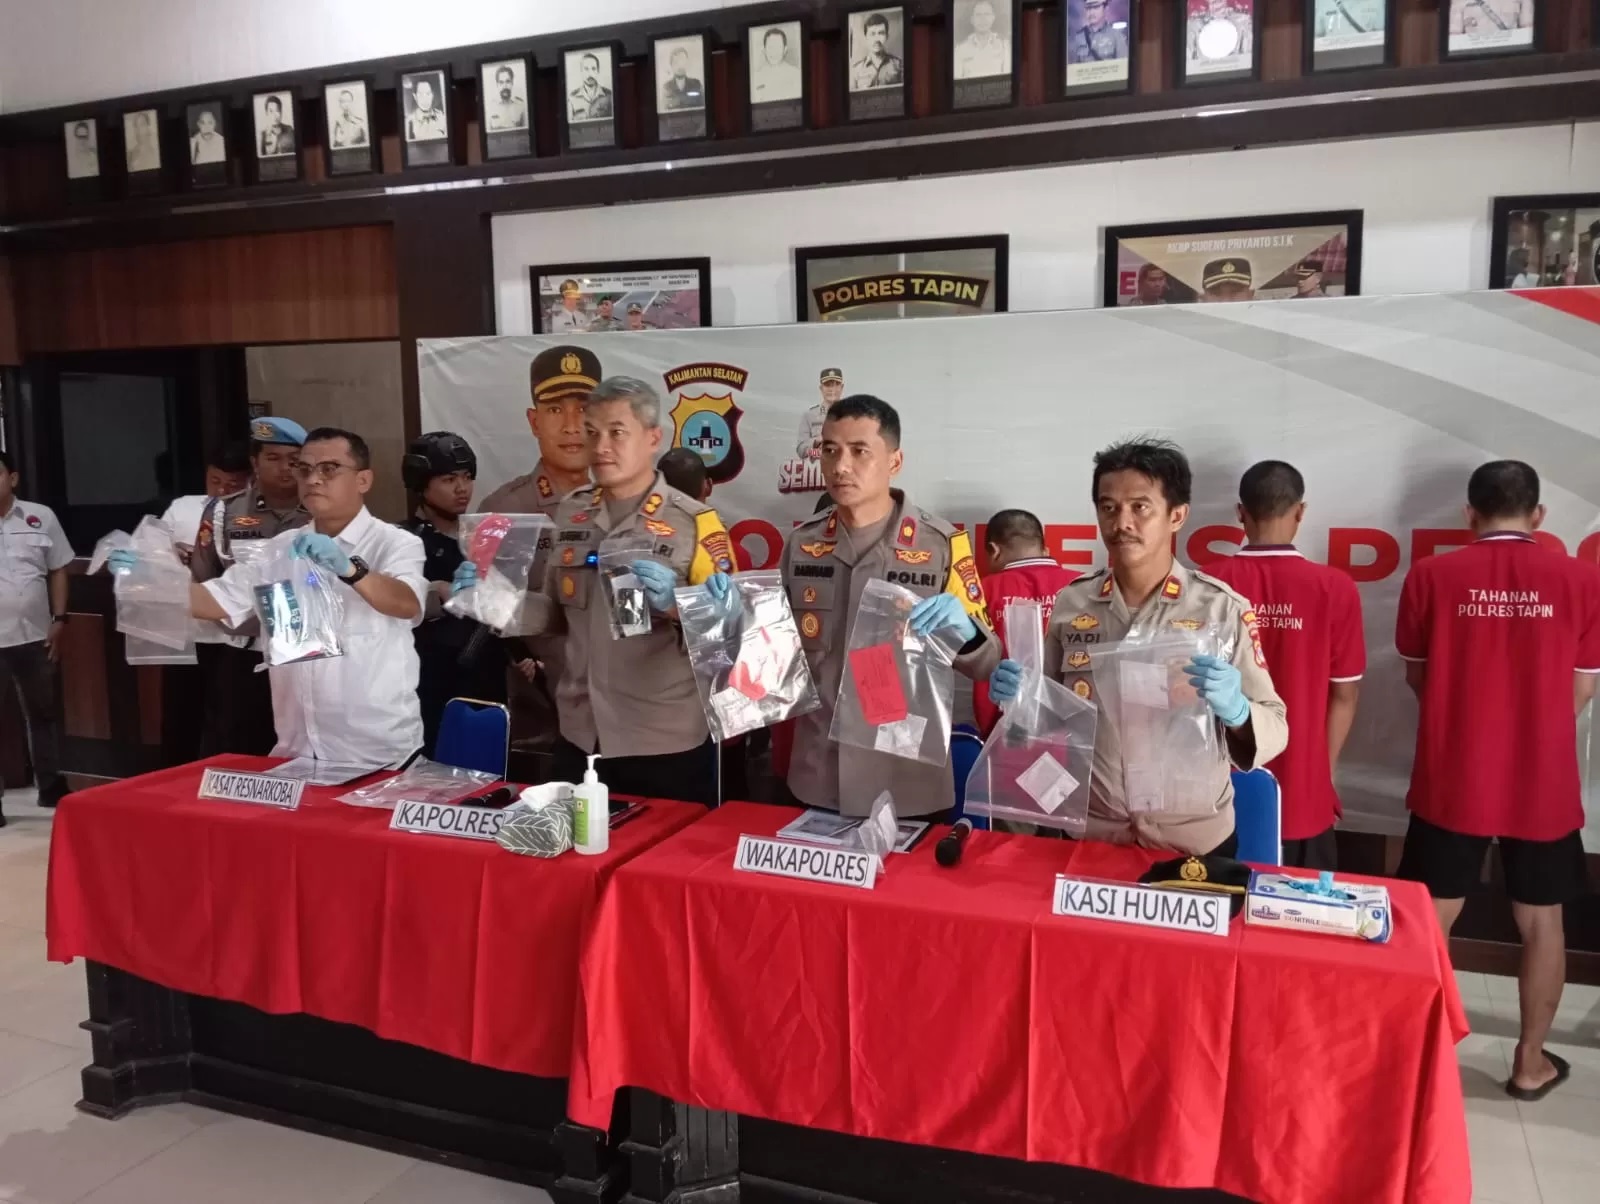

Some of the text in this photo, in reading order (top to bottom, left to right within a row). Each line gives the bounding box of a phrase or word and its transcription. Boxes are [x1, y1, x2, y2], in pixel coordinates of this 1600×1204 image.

[1227, 236, 1270, 250] PRIYANTO
[821, 278, 980, 308] POLRES TAPIN
[668, 367, 744, 385] KALIMANTAN SELATAN
[778, 458, 827, 492] SEM
[887, 570, 937, 588] POLRI
[1468, 589, 1539, 603] TAHANAN
[1250, 603, 1293, 615] HANAN
[1458, 603, 1553, 618] POLRES TAPIN
[1271, 617, 1303, 630] TAPIN
[1065, 632, 1101, 644] YADI
[207, 773, 294, 803] KASAT RESNARKOBA
[399, 803, 503, 835] KAPOLRES
[746, 841, 867, 882] WAKAPOLRES
[1064, 883, 1217, 928] KASI HUMAS
